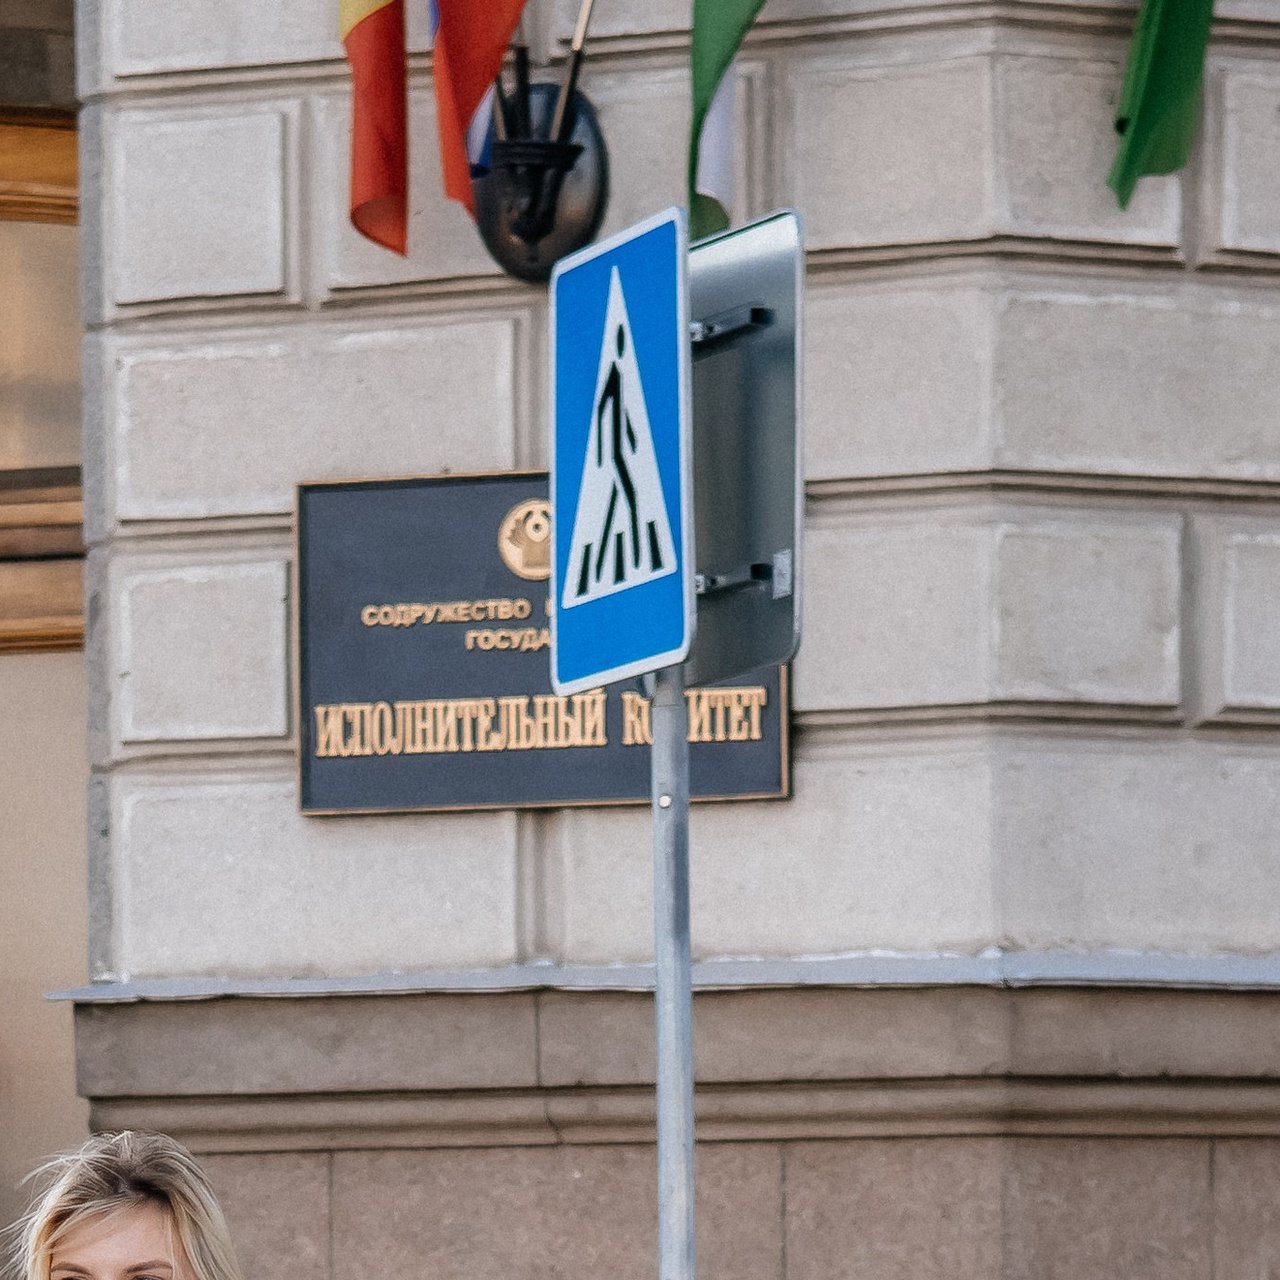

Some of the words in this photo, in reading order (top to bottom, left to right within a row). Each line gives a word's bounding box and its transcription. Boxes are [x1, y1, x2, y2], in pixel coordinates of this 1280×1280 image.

[361, 598, 532, 627] СОДРУЖЕСТВО
[314, 687, 608, 758] ИСПОЛНИТЕЛЬНЫЙ
[621, 685, 766, 746] КОИТЕТ
